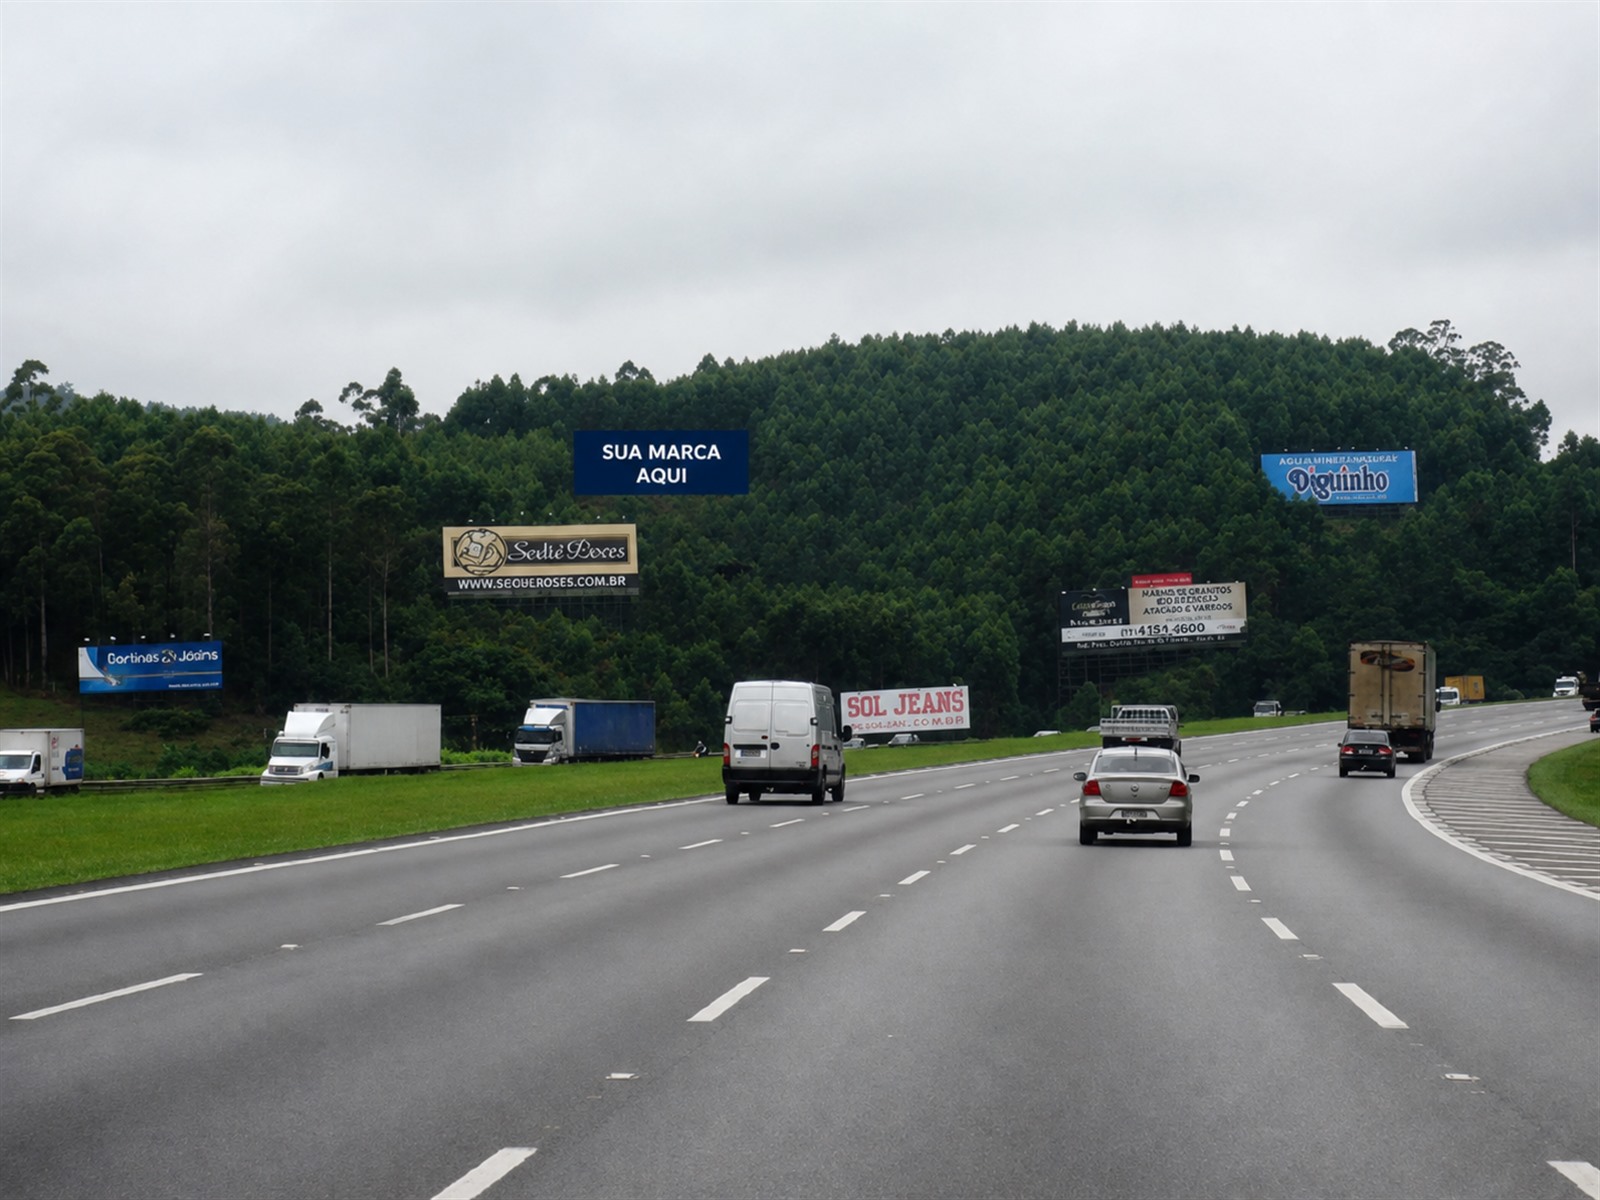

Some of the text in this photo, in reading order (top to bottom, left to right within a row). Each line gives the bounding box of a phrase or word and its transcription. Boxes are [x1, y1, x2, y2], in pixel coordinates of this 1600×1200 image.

[602, 444, 721, 460] SUA MARCA
[636, 467, 687, 485] AQUI
[847, 690, 964, 718] SOL JEANS
